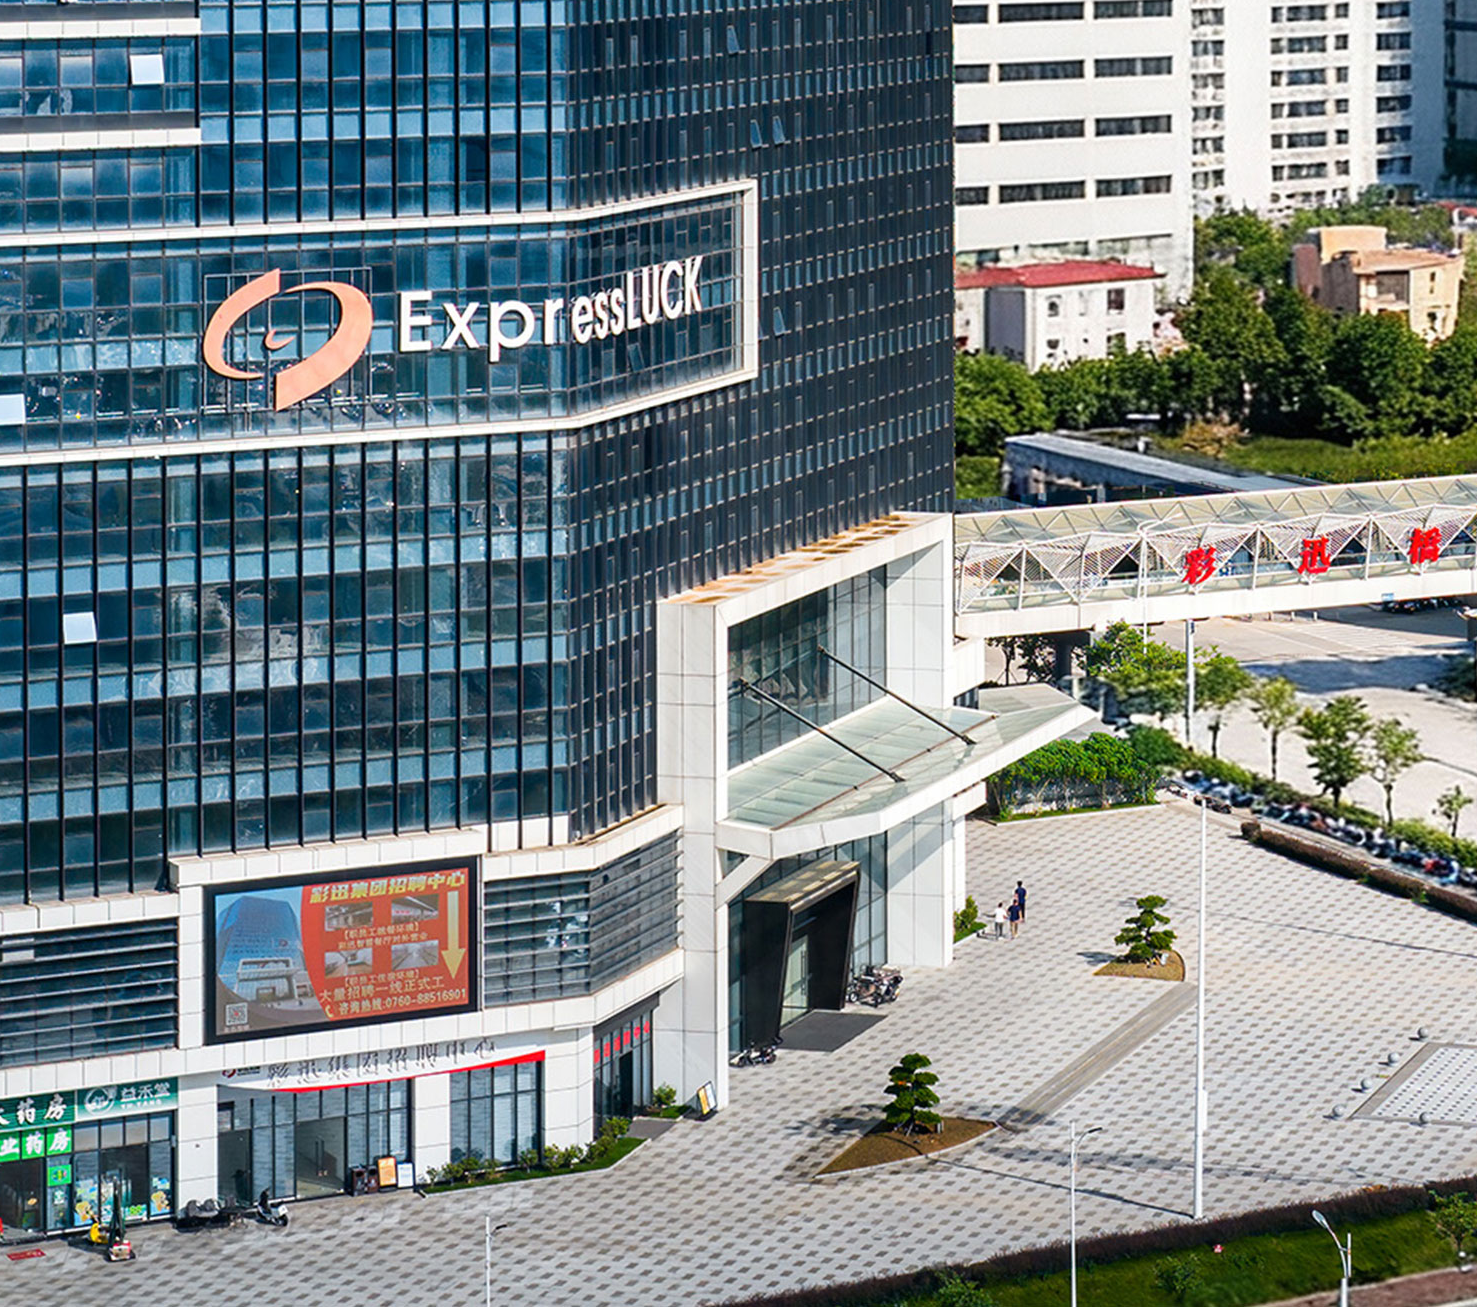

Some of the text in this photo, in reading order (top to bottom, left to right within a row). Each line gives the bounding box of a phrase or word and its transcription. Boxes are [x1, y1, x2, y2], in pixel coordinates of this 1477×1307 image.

[399, 254, 704, 363] ExpressLUCK
[309, 870, 466, 904] 彩迅集团招聘中心
